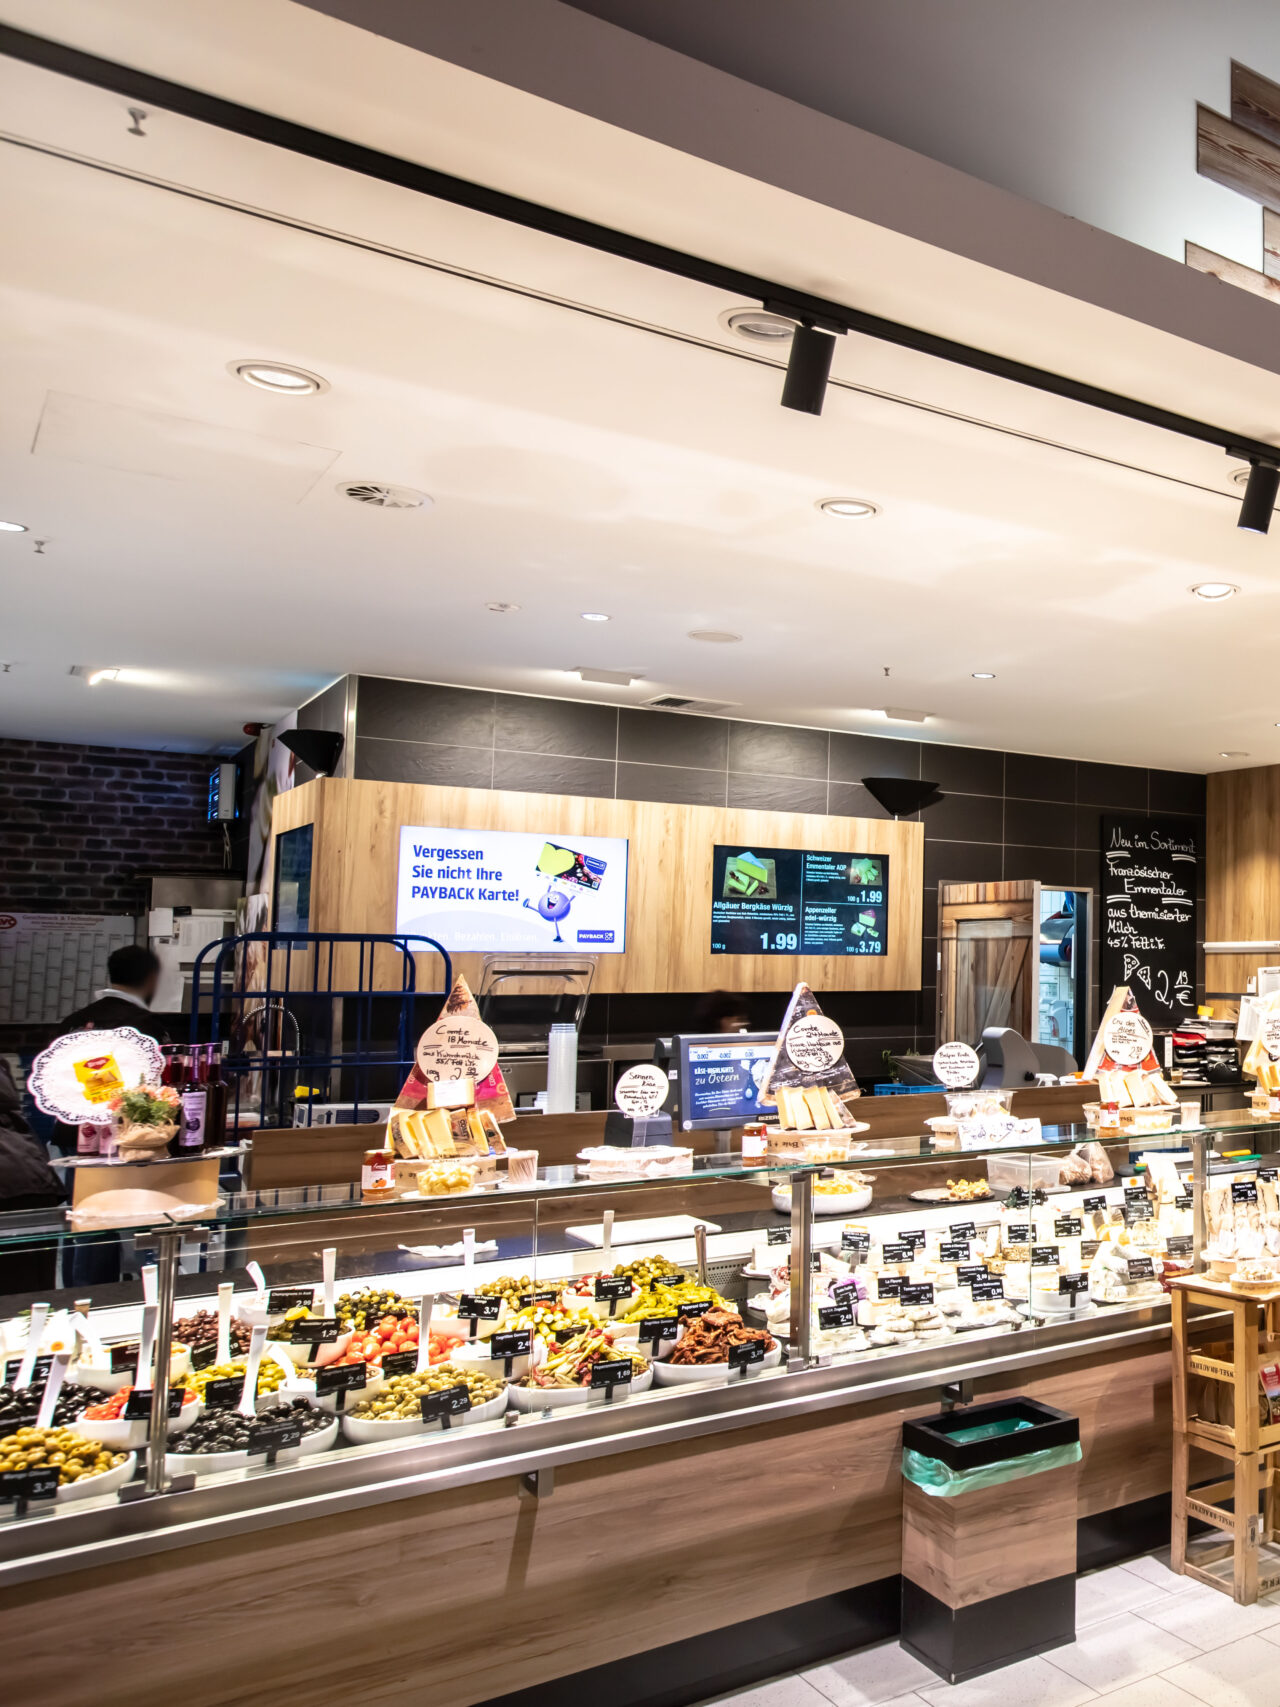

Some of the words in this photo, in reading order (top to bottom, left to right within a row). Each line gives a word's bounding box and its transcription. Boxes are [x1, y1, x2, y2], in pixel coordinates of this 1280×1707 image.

[1110, 827, 1132, 848] Neu
[1134, 835, 1149, 849] im
[1151, 831, 1196, 854] Sortiment
[413, 844, 484, 861] Vergessen
[806, 855, 832, 863] Schweizer
[412, 865, 433, 878] Sie
[437, 866, 472, 880] nicht
[477, 868, 502, 881] Ihre
[806, 863, 836, 871] Emmentaler
[1106, 858, 1173, 880] Französischer
[412, 886, 475, 900] PAYBACK
[479, 888, 519, 901] Karte!
[1124, 878, 1187, 897] Emmentaler
[861, 890, 882, 903] 1.99
[713, 901, 740, 911] Allgäuer
[741, 902, 771, 912] Bergkäse
[772, 904, 793, 913] Würzig
[1107, 908, 1127, 918] aus
[1107, 919, 1138, 934] Milch
[760, 932, 797, 950] 1.99
[859, 941, 881, 953] 3.79
[1107, 936, 1128, 948] 45%
[457, 1036, 488, 1047] Monate
[708, 1073, 740, 1084] Ostern
[1190, 1361, 1235, 1378] NSEL-BRAUEREI
